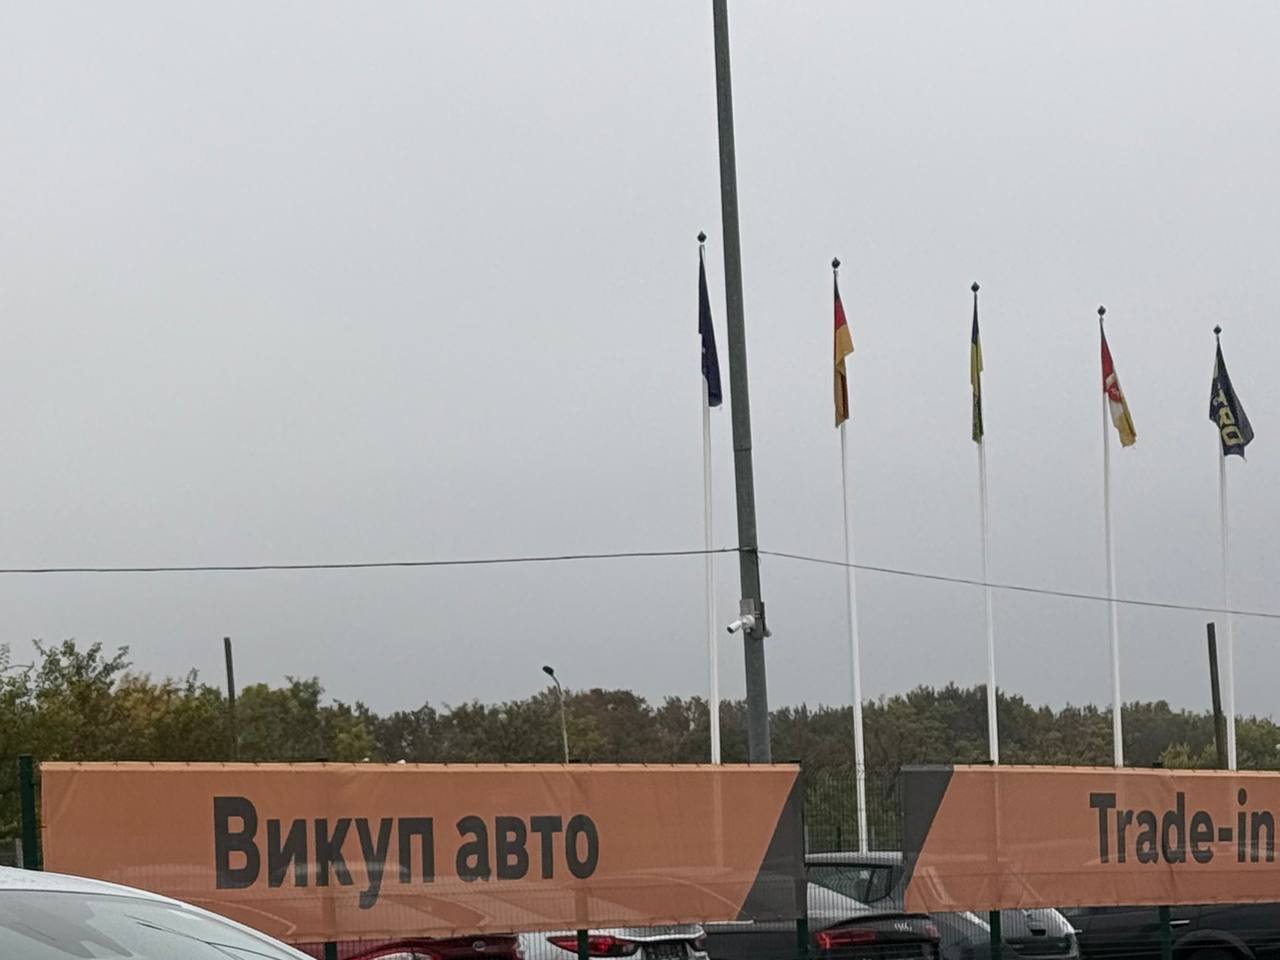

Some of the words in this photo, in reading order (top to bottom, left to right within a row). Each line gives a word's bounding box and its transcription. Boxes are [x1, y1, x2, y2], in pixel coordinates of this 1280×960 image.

[213, 796, 435, 909] Викуп
[456, 814, 599, 882] авто
[1089, 788, 1275, 864] Trade-in
